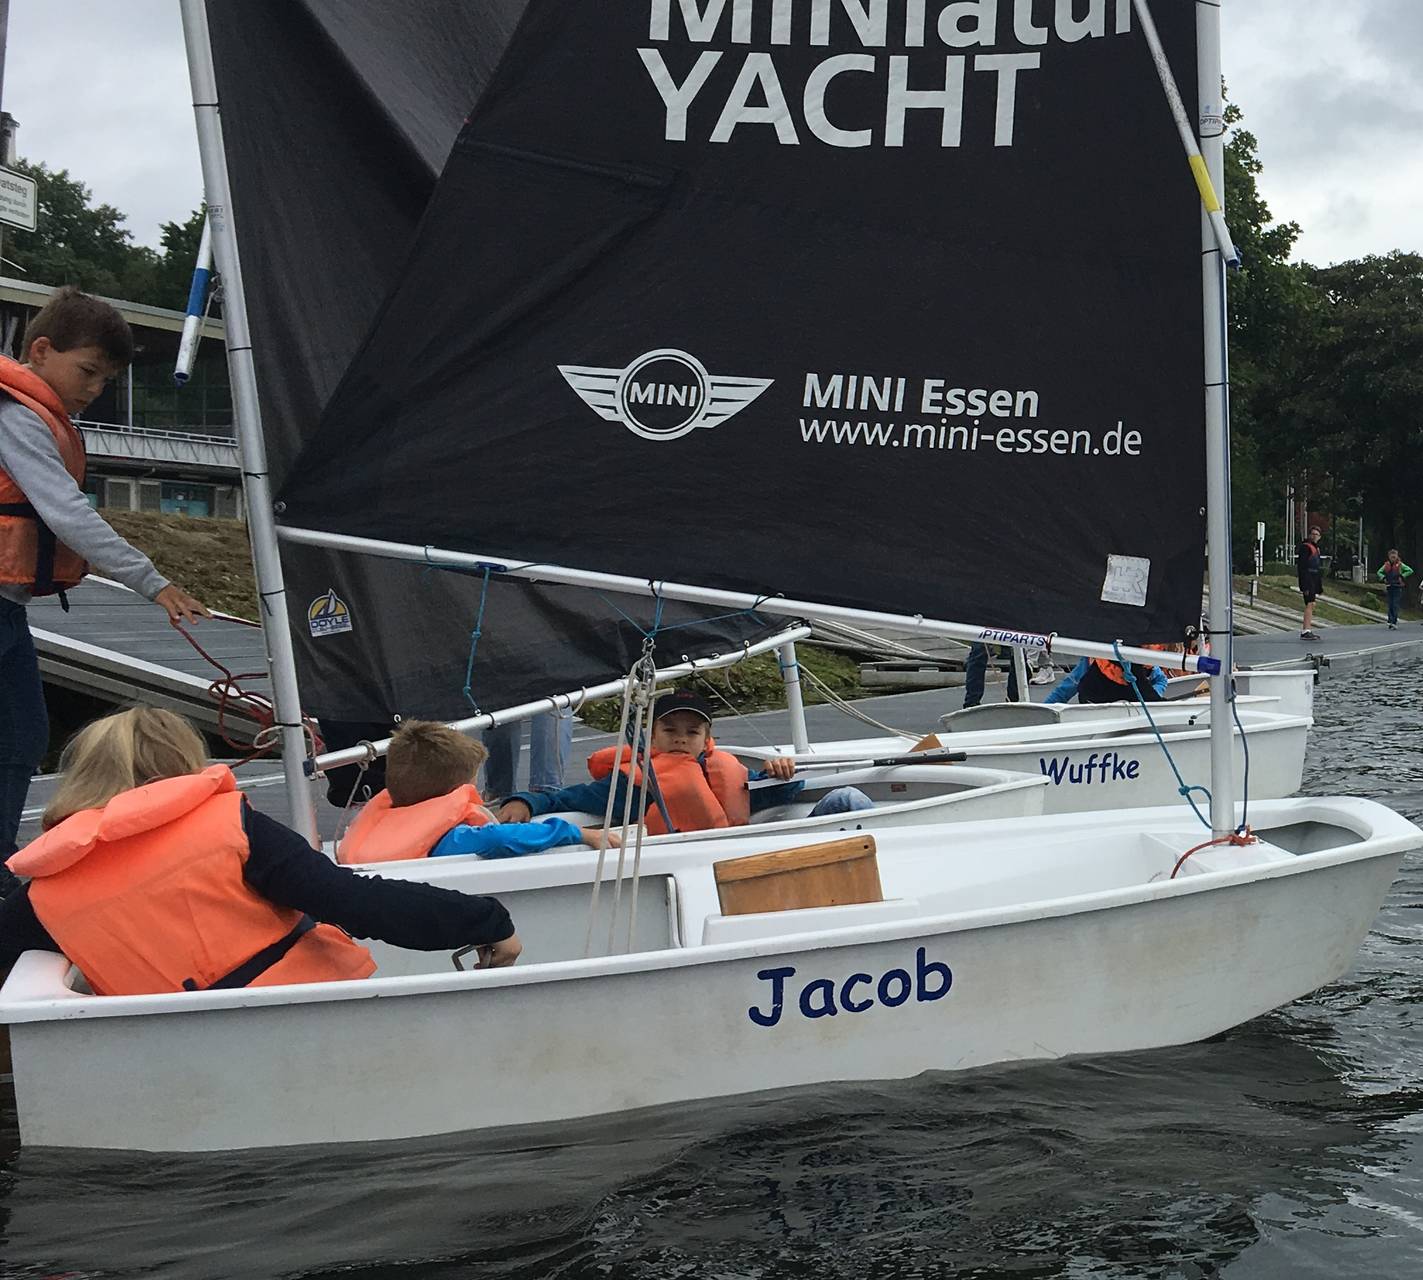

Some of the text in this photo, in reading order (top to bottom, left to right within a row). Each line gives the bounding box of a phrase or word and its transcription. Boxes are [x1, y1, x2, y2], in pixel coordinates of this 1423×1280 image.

[636, 47, 1041, 148] YACHT
[630, 381, 698, 407] MINI
[803, 372, 1039, 418] MINI Essen
[799, 418, 1143, 456] www.mini-essen.de
[311, 615, 349, 628] DOYLE
[1040, 752, 1140, 785] Wuffke
[749, 947, 953, 1027] Jacob
